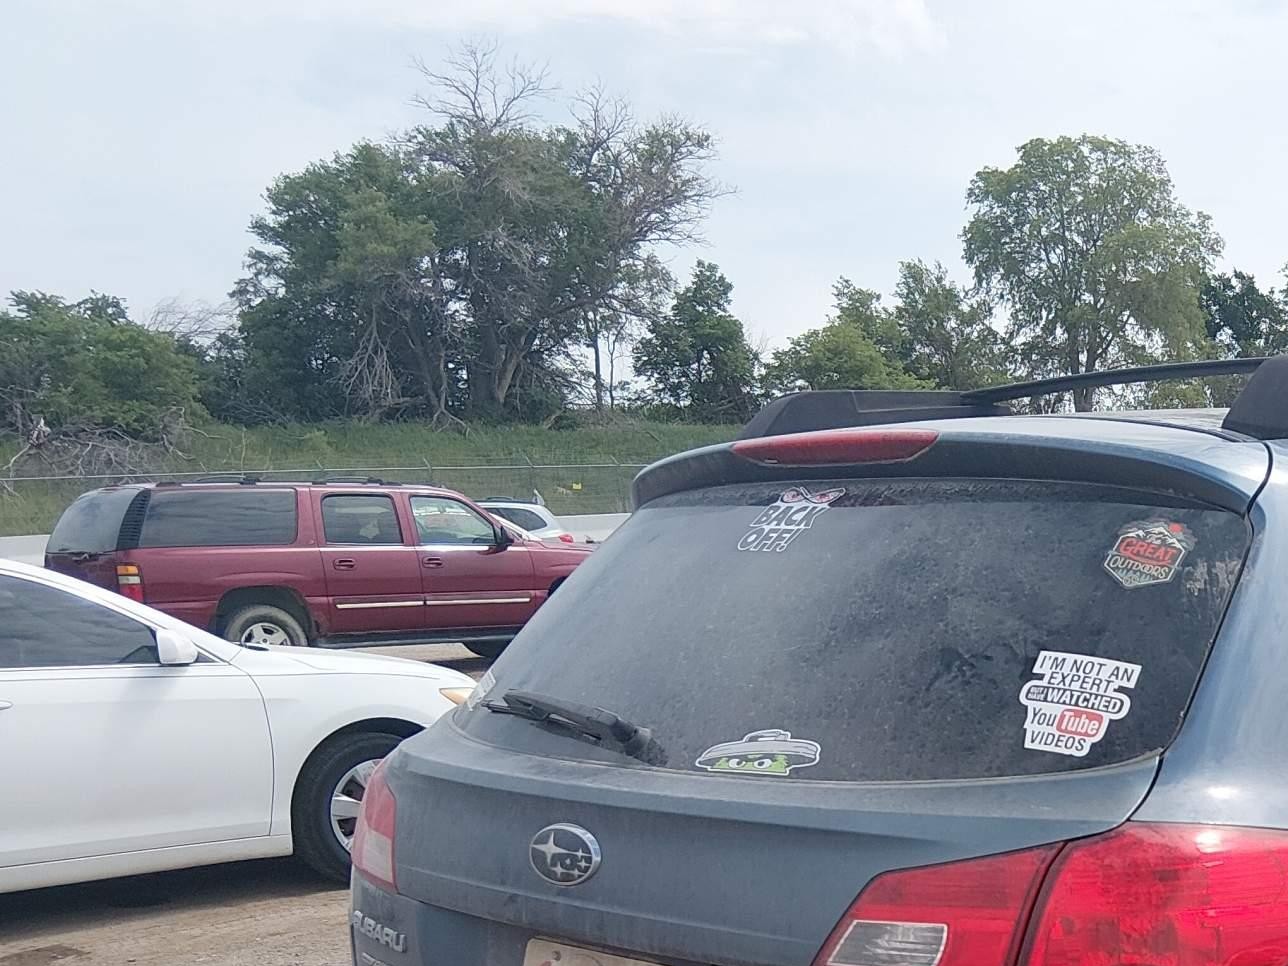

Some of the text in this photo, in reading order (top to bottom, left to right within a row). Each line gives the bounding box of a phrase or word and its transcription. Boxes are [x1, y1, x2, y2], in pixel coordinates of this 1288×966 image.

[751, 505, 829, 528] BACK
[1120, 537, 1177, 563] GREAT
[1109, 555, 1169, 579] OUTDOORS
[1040, 655, 1135, 682] I'M NOT AN
[1047, 671, 1115, 694] EXPERT
[1046, 688, 1121, 713] WATCHED
[1030, 731, 1087, 752] VIDEOS
